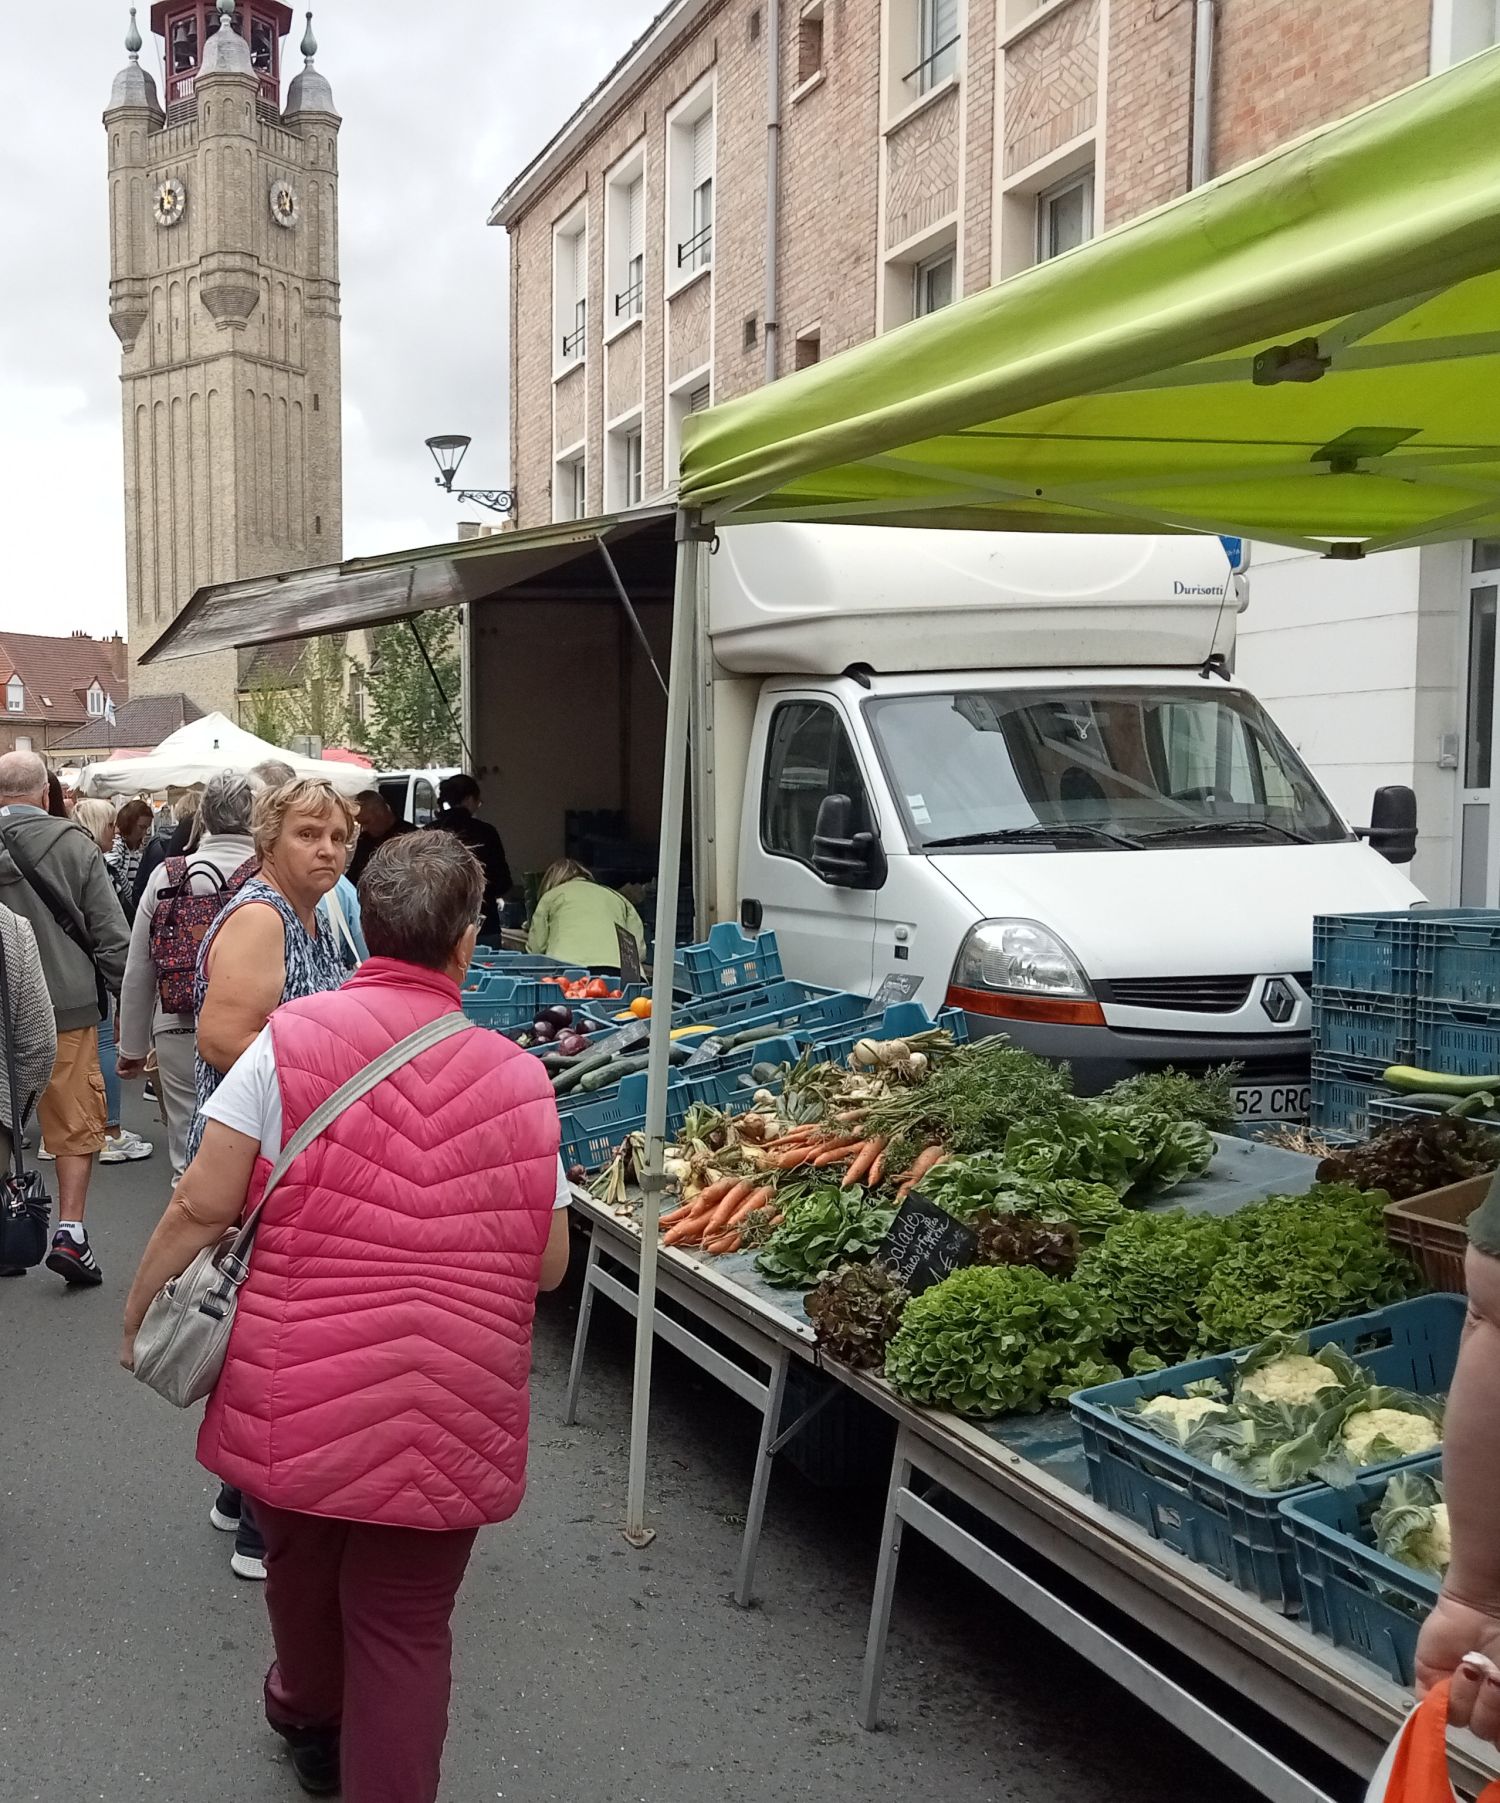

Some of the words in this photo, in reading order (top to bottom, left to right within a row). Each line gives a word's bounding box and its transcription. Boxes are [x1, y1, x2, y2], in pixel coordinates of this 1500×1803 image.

[1174, 580, 1223, 595] Durisotti
[1235, 1089, 1263, 1115] 52
[877, 1212, 925, 1271] Salades
